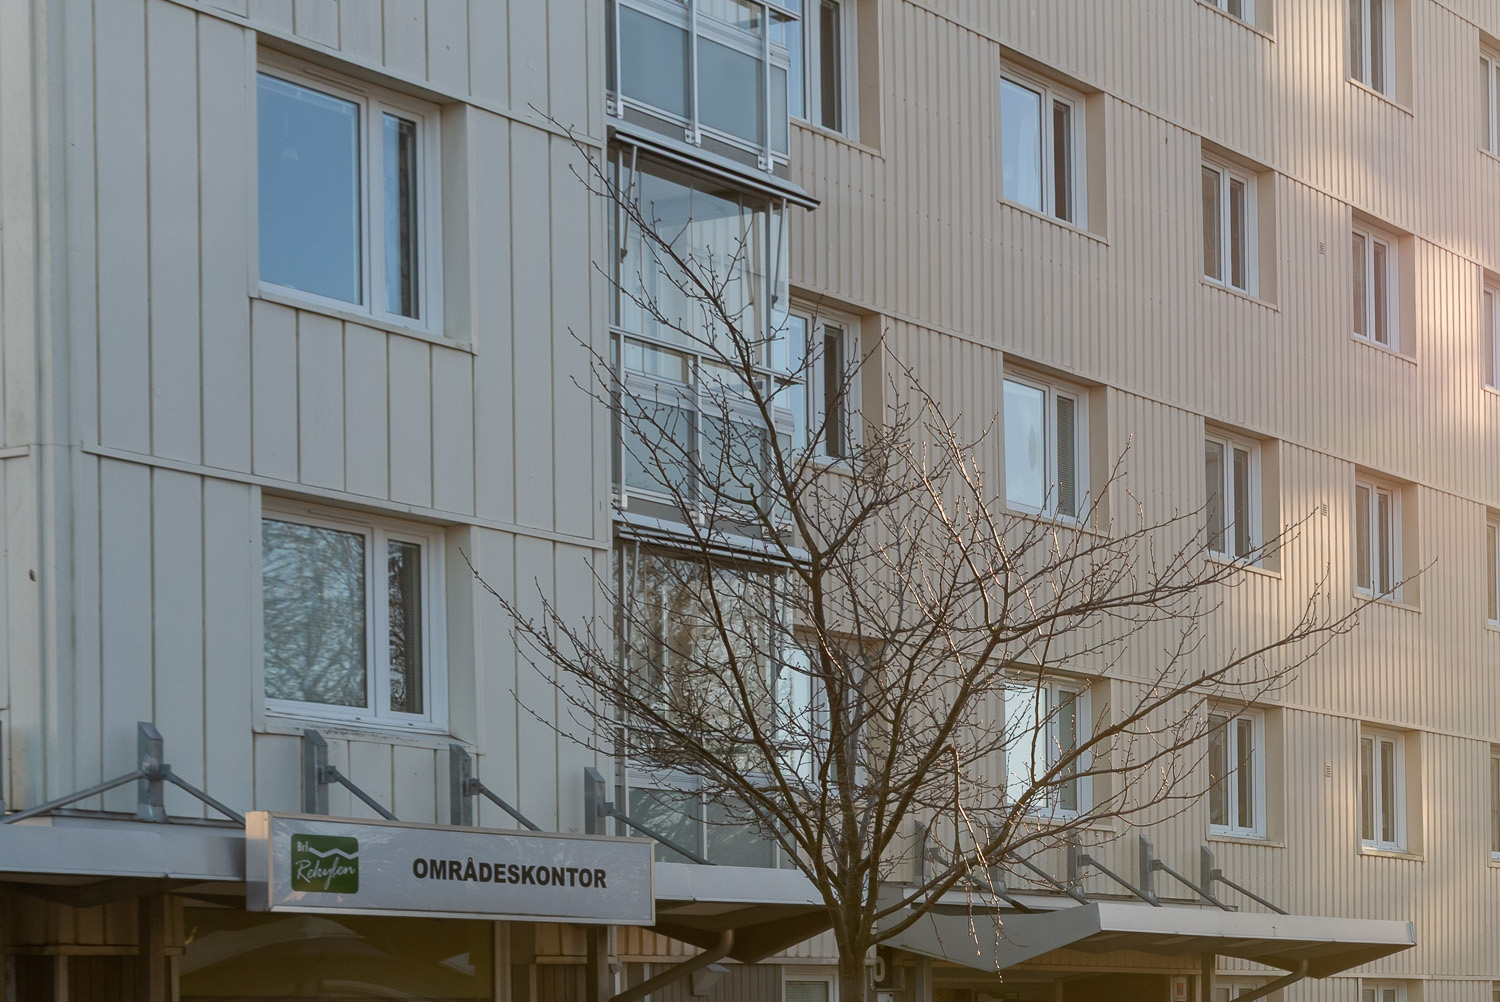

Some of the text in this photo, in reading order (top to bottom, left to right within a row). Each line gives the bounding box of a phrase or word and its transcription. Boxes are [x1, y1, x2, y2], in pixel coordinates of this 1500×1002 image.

[297, 841, 309, 852] Brf
[296, 857, 356, 891] Rekylen
[413, 857, 607, 888] OMRÅDESKONTOR
